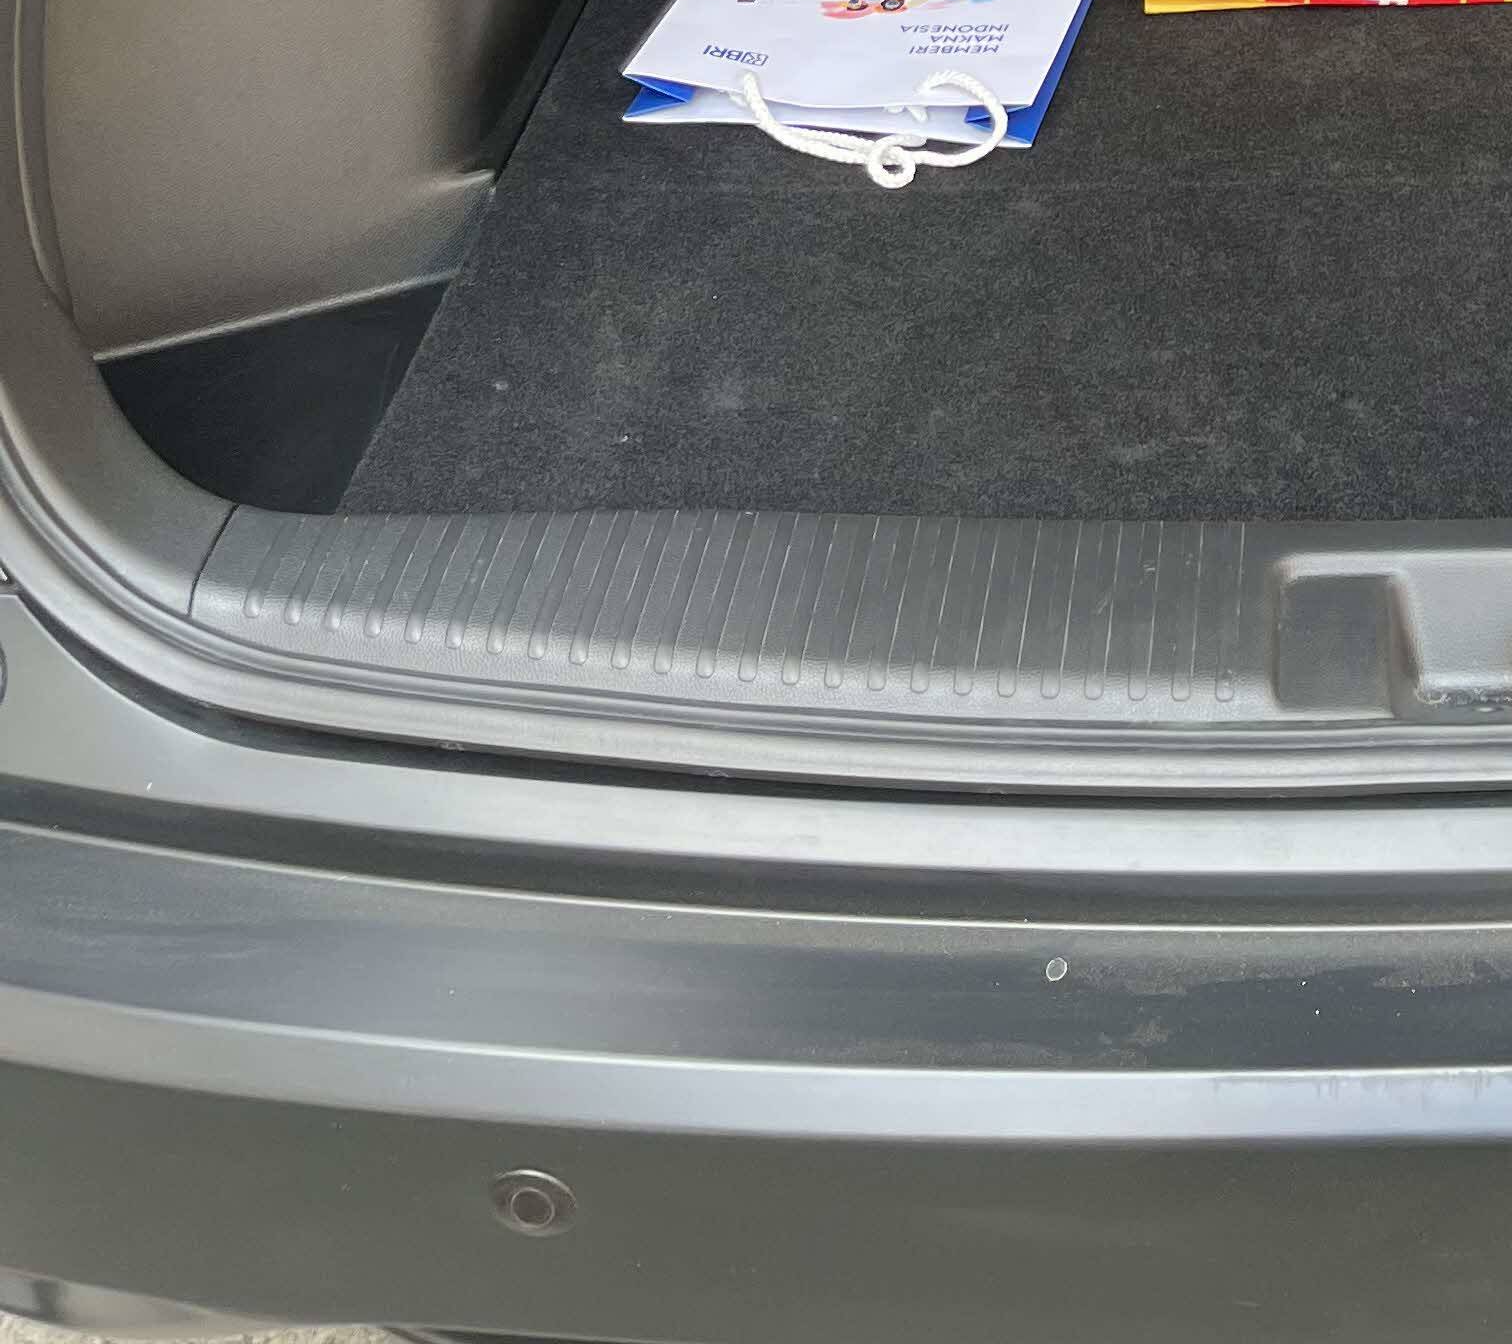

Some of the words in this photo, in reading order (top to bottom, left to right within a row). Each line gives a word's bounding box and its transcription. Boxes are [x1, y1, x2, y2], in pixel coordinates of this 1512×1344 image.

[900, 24, 1009, 33] INDONESIA
[930, 34, 1004, 43] MAKNA
[702, 45, 744, 61] BRI
[909, 44, 999, 54] MEMBERI
